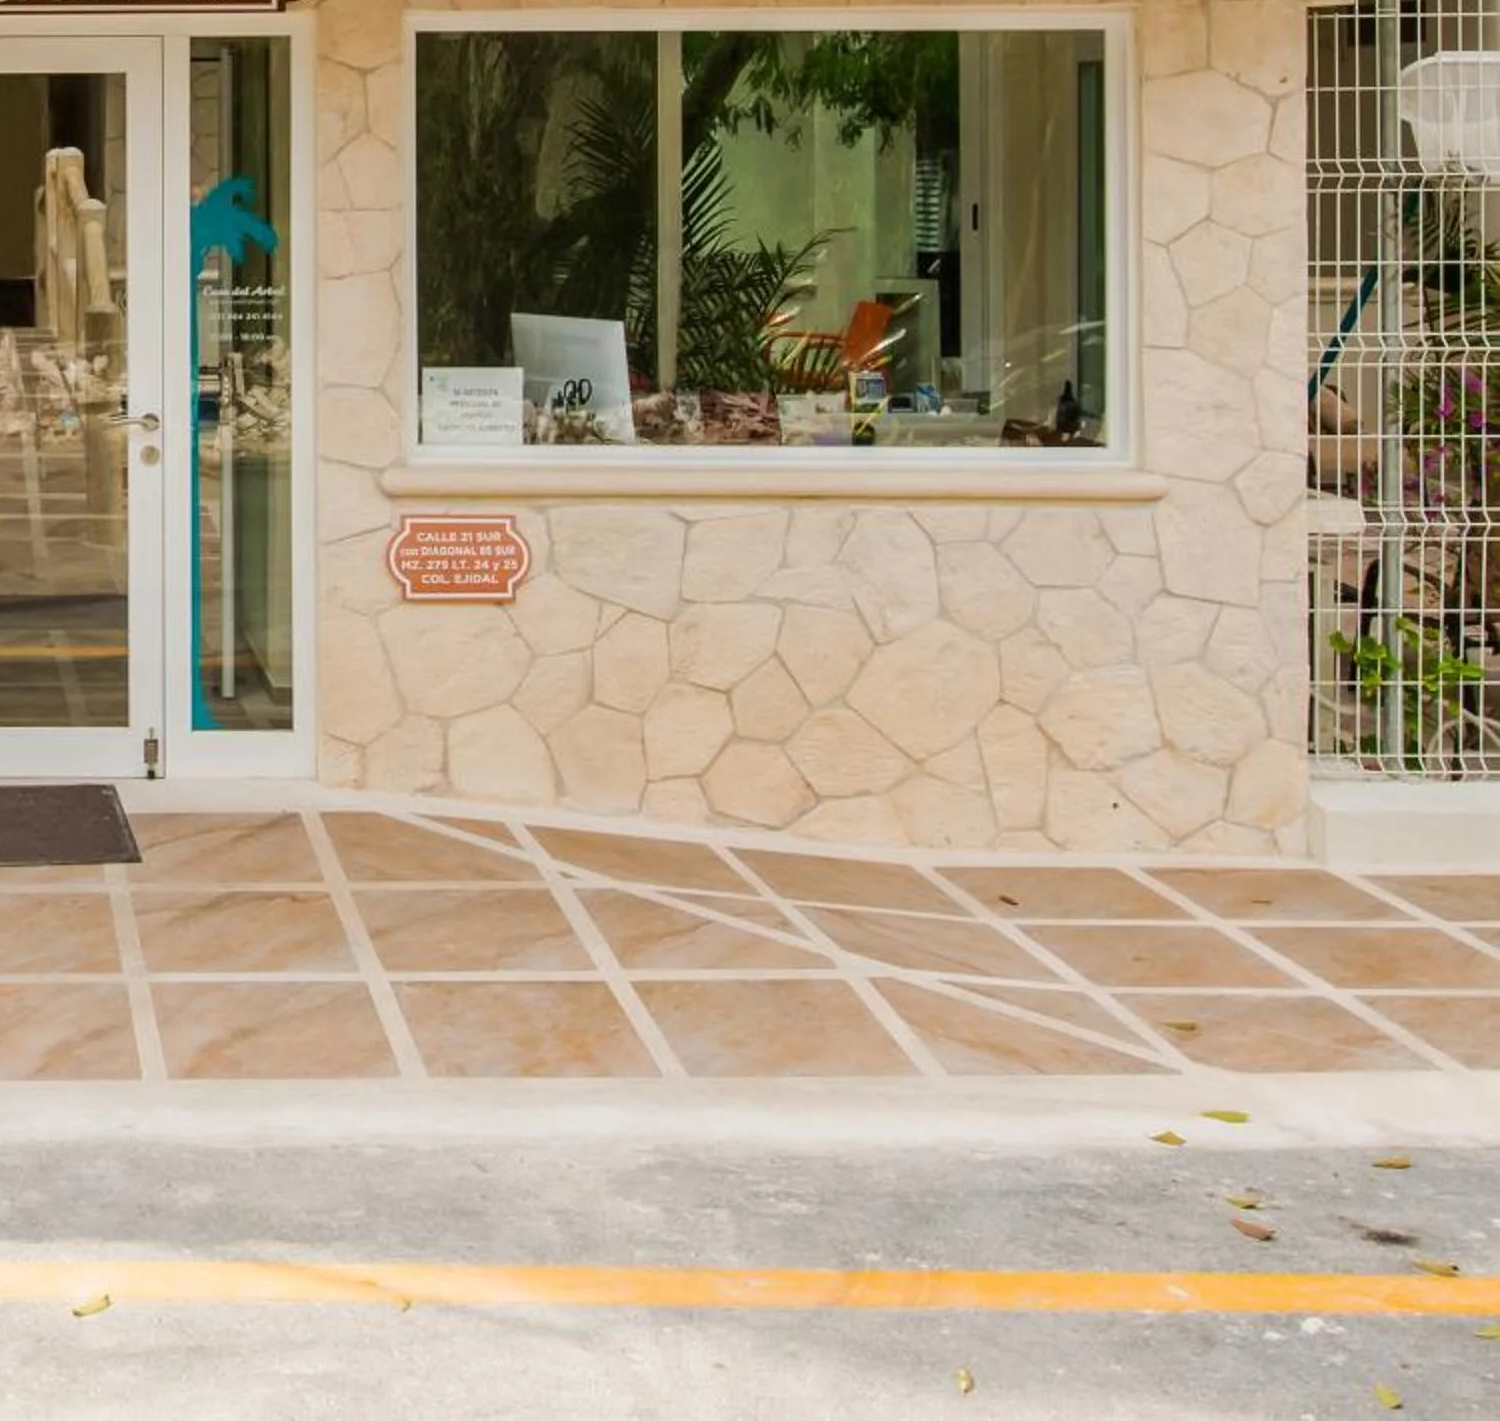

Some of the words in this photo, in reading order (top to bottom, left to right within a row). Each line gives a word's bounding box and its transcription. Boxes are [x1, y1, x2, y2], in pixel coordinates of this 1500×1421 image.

[416, 531, 457, 542] CALLE
[476, 531, 502, 542] SUR
[421, 546, 478, 556] DIAGONAL
[495, 546, 516, 556] SUR
[453, 573, 501, 584] EJIDAL
